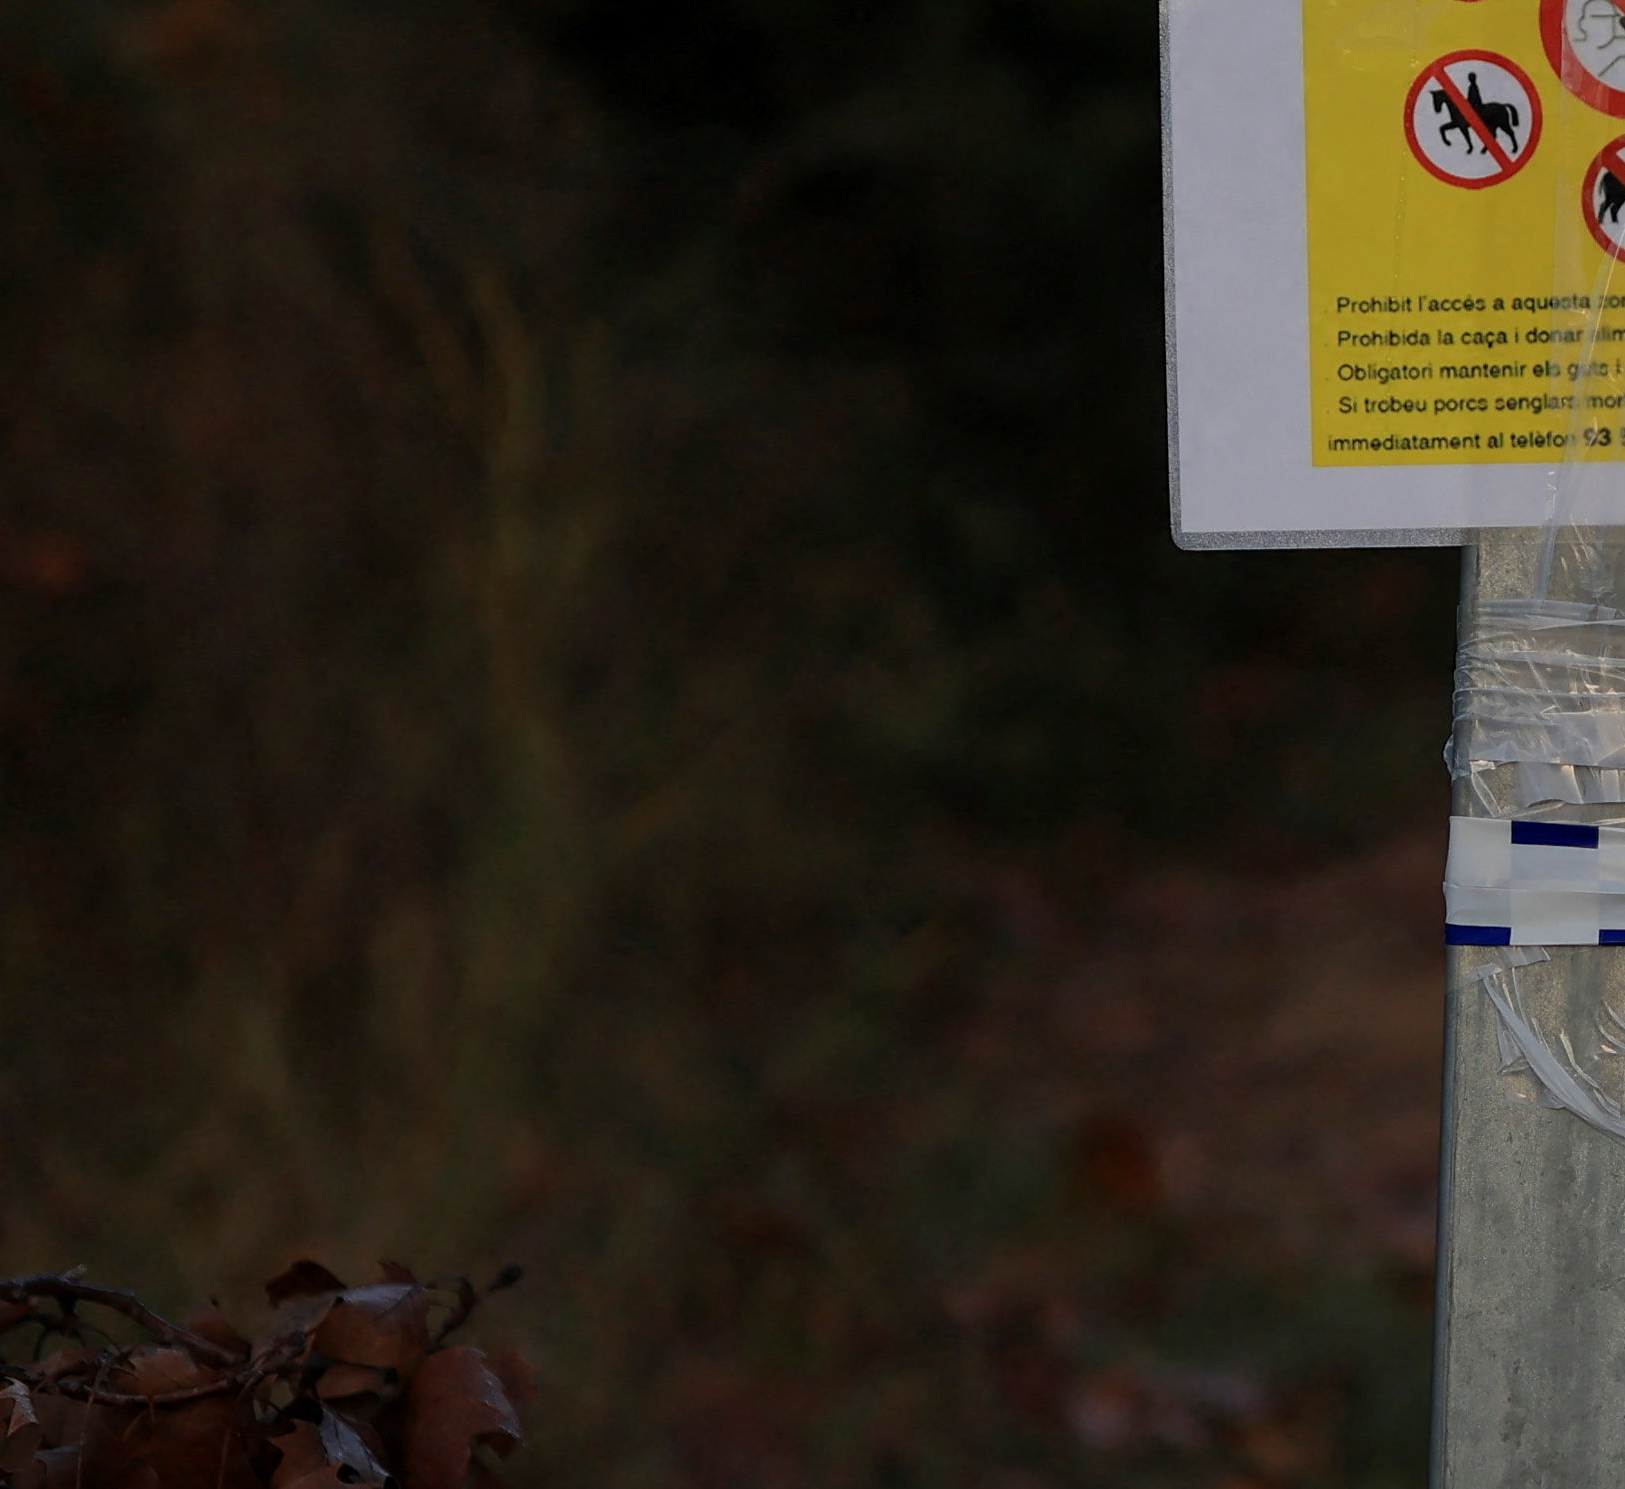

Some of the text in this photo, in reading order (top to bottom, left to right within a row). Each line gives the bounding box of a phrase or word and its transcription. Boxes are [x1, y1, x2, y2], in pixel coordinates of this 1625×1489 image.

[1337, 295, 1412, 313] Prohibit
[1493, 298, 1505, 310] a
[1511, 294, 1591, 314] aquesta
[1337, 329, 1430, 347] Prohibida
[1437, 329, 1454, 345] la
[1461, 331, 1508, 349] caça
[1515, 328, 1519, 343] i
[1526, 327, 1584, 344] donar
[1337, 364, 1433, 384] Obligatori
[1439, 361, 1525, 379] mantenir
[1533, 361, 1561, 376] els
[1616, 360, 1621, 375] i
[1339, 396, 1358, 415] Si
[1364, 396, 1427, 413] trobeu
[1434, 397, 1488, 416] porcs
[1329, 433, 1480, 452] immediatament
[1487, 433, 1503, 449] al
[1583, 427, 1612, 448] 93
